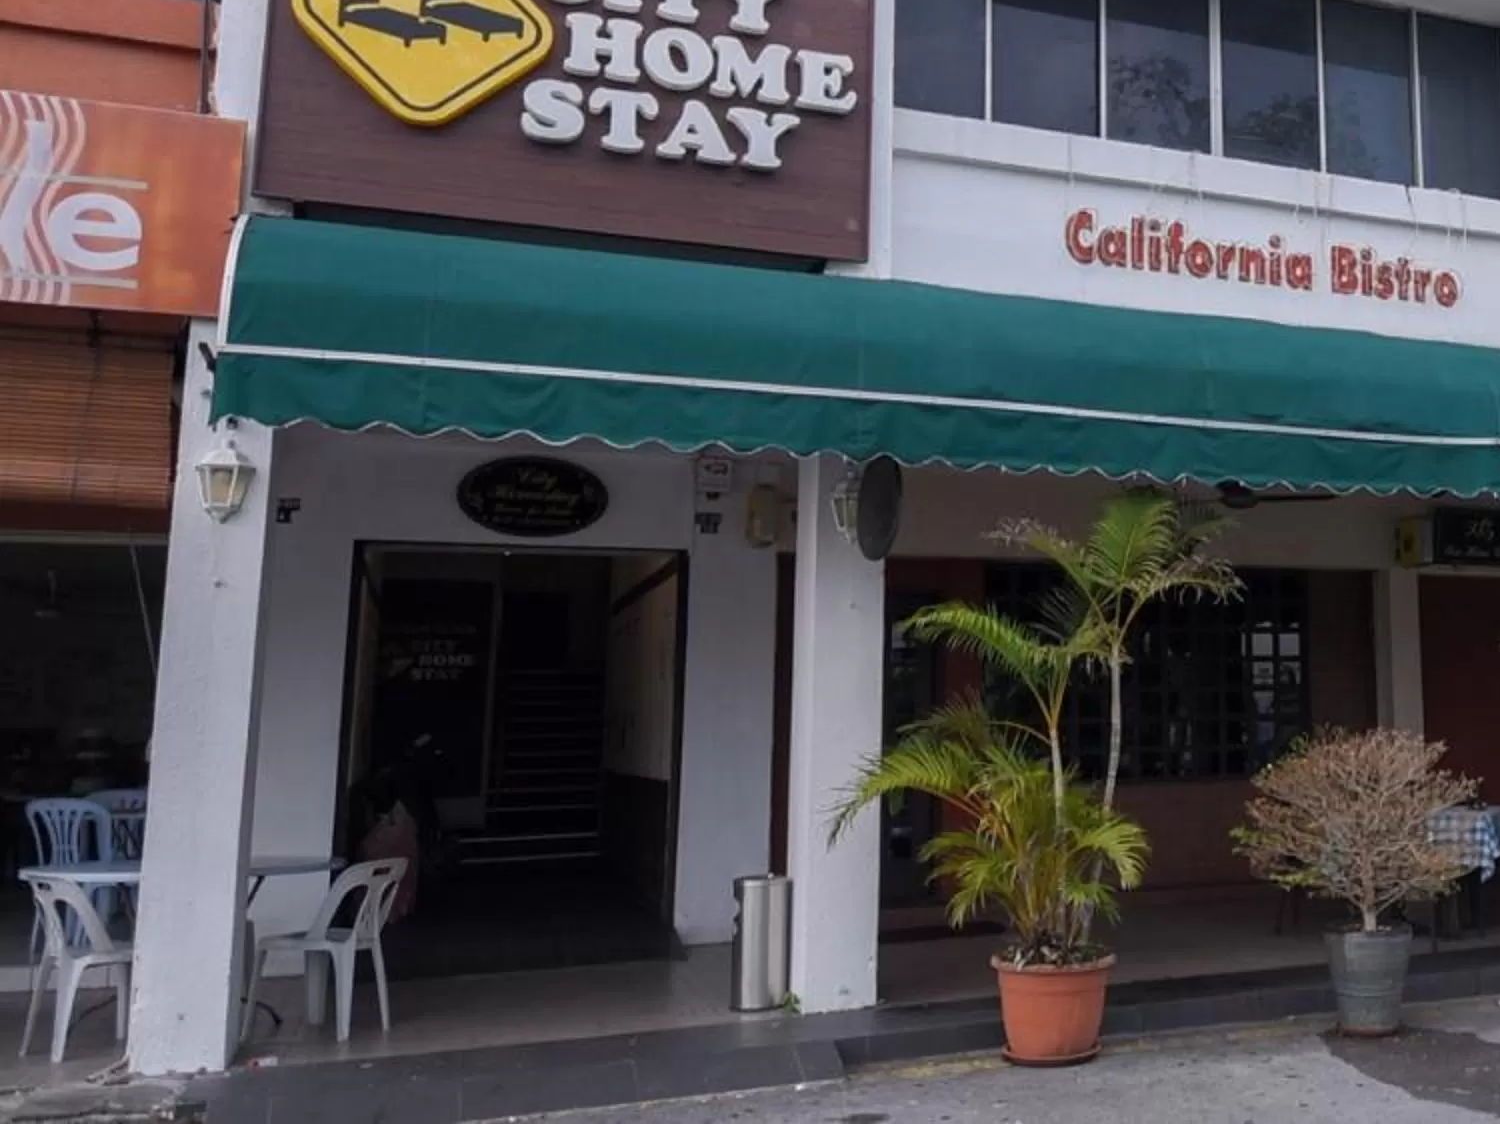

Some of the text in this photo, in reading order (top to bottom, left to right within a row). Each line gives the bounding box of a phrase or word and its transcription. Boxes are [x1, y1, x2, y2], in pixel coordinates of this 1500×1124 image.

[562, 11, 858, 116] HOME
[520, 78, 801, 170] STAY
[1065, 208, 1462, 308] California Bistro
